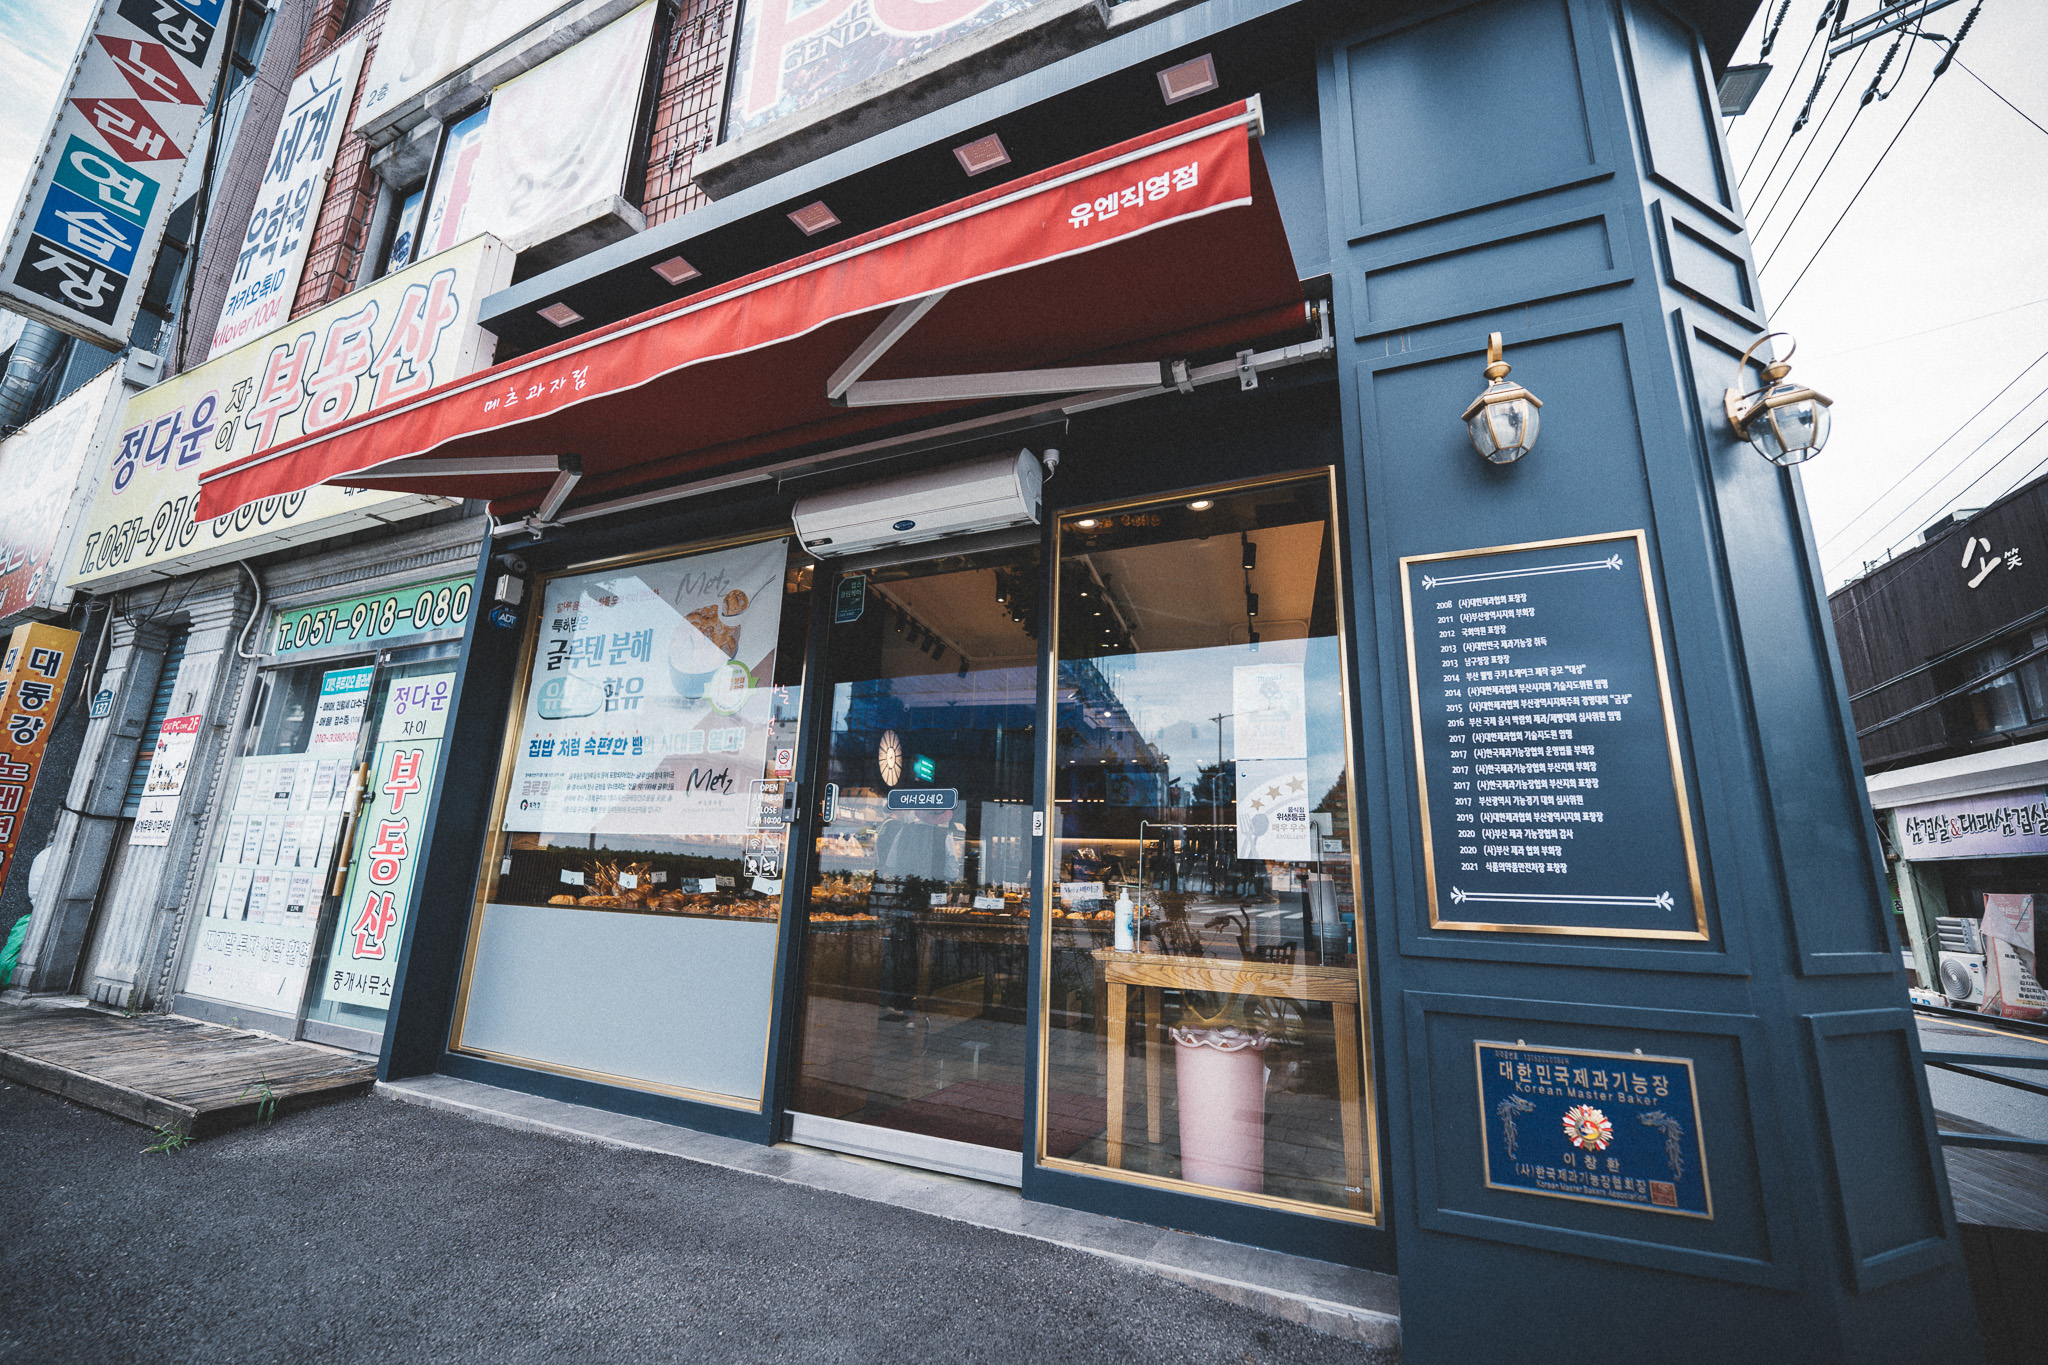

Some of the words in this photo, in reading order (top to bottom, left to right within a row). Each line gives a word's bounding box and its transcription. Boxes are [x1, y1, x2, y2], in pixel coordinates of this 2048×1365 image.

[367, 83, 389, 107] 2층
[265, 86, 343, 184] 세계
[32, 41, 181, 307] 노래연습장
[1068, 161, 1198, 229] 유엔직영점
[235, 174, 318, 284] 유학원
[111, 391, 219, 493] 정다운
[246, 267, 459, 455] 부동산
[675, 568, 732, 605] Metz
[1436, 600, 1453, 610] 2008
[1507, 593, 1527, 603] 표창장
[1437, 616, 1454, 624] 2011
[1515, 607, 1535, 617] 부회장
[551, 616, 589, 633] 특허받은
[1439, 630, 1455, 638] 2012
[1461, 626, 1486, 637] 국회의원
[1487, 624, 1506, 635] 표창장
[547, 634, 605, 671] 글루텐
[609, 628, 654, 666] 분해
[1440, 645, 1457, 653] 2013
[1500, 638, 1533, 649] 제과기능장
[1441, 659, 1458, 668] 2013
[1464, 656, 1489, 667] 남구청장
[1490, 654, 1510, 664] 표창장
[1443, 674, 1460, 683] 2014
[1466, 672, 1479, 681] 부산
[1494, 670, 1508, 679] 쿠키
[1549, 666, 1564, 676] 공모
[8, 647, 63, 745] 대동강
[602, 676, 644, 713] 함유
[1445, 689, 1461, 697] 2014
[1594, 679, 1608, 690] 임명
[393, 681, 448, 716] 정다운
[95, 702, 109, 714] 137
[1446, 704, 1463, 713] 2015
[187, 716, 199, 731] 2F
[1447, 718, 1465, 727] 2016
[1469, 718, 1482, 727] 부산
[1483, 717, 1496, 726] 국제
[1498, 716, 1511, 726] 음식
[1511, 715, 1532, 725] 박람회
[1578, 711, 1606, 722] 심사위원
[1607, 711, 1621, 721] 임명
[402, 720, 427, 736] 자이
[1449, 735, 1465, 743] 2017
[1558, 729, 1573, 739] 임명
[528, 738, 555, 758] 집밥
[557, 738, 581, 757] 처럼
[584, 736, 628, 757] 속편한
[1450, 750, 1467, 759] 2017
[1574, 745, 1595, 755] 부회장
[1452, 766, 1469, 775] 2017
[1576, 761, 1597, 772] 부회장
[685, 767, 736, 797] Metz
[1454, 782, 1470, 791] 2017
[1578, 778, 1599, 789] 표창장
[900, 794, 944, 805] 어서오세요
[1455, 797, 1472, 806] 2017
[1479, 796, 1511, 806] 부산광역시
[1540, 795, 1554, 805] 대회
[1556, 794, 1584, 805] 심사위원
[757, 806, 777, 814] CLOSE
[1276, 812, 1306, 821] 위생등급
[1456, 813, 1474, 823] 2019
[1582, 812, 1604, 823] 표창장
[764, 816, 782, 824] 10:00
[1272, 823, 1288, 832] 매우
[1290, 823, 1306, 832] 우수
[1458, 829, 1475, 838] 2020
[1482, 829, 1508, 839] (사)부산
[1509, 829, 1523, 839] 제과
[1524, 829, 1558, 839] 기능장협회
[1559, 829, 1573, 839] 감사
[352, 749, 425, 960] 부동산
[1460, 846, 1477, 854] 2020
[1483, 845, 1509, 856] (사)부산
[1511, 846, 1524, 856] 제과
[1525, 846, 1540, 856] 협회
[1541, 846, 1562, 856] 부회장
[1461, 862, 1478, 871] 2021
[1485, 862, 1545, 873] 식품의약품안전처장
[1546, 863, 1567, 873] 표창장
[333, 970, 391, 997] 중개사무소
[1499, 1061, 1669, 1097] 대한민국제과기능장
[1515, 1081, 1562, 1096] Korean
[1567, 1086, 1613, 1101] Master
[1618, 1092, 1658, 1107] Baker
